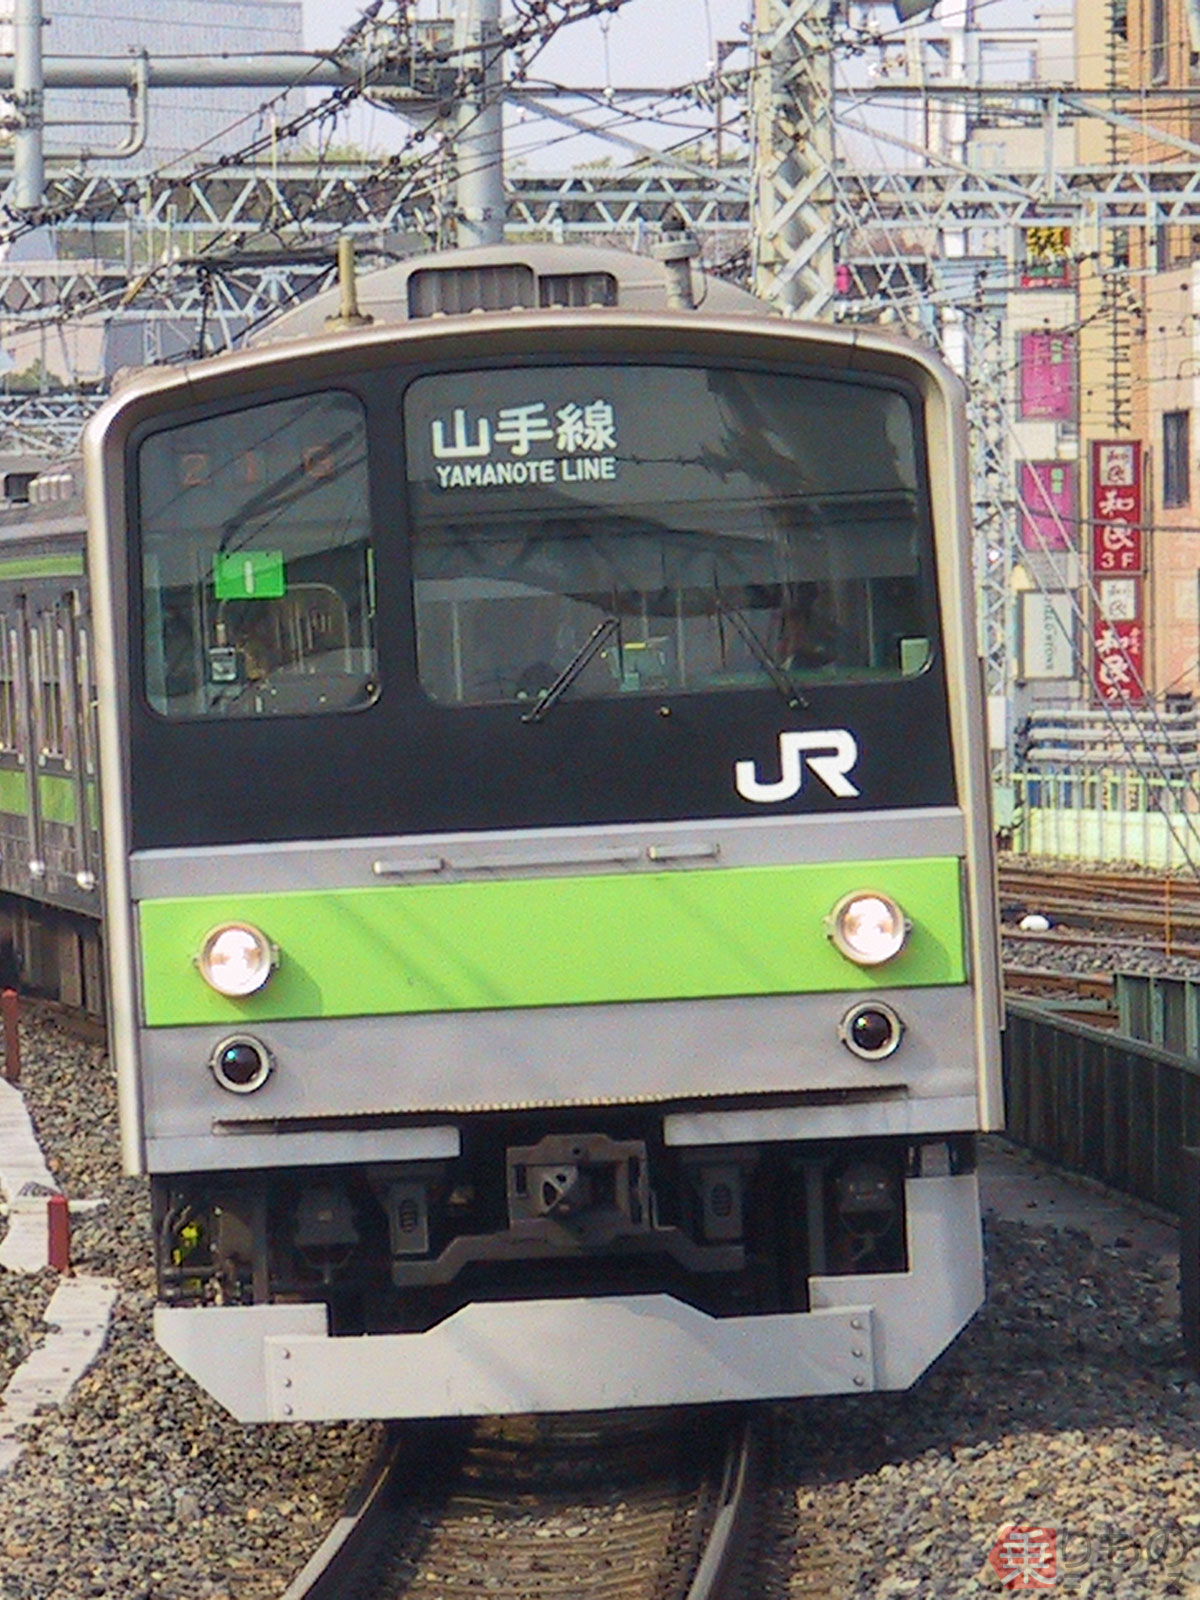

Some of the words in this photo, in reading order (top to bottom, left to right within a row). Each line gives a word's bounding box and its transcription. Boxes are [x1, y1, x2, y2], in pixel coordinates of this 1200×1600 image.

[432, 400, 617, 458] 山手線
[436, 460, 555, 488] YAMANOTE
[562, 457, 617, 482] LINE
[736, 729, 861, 802] JR
